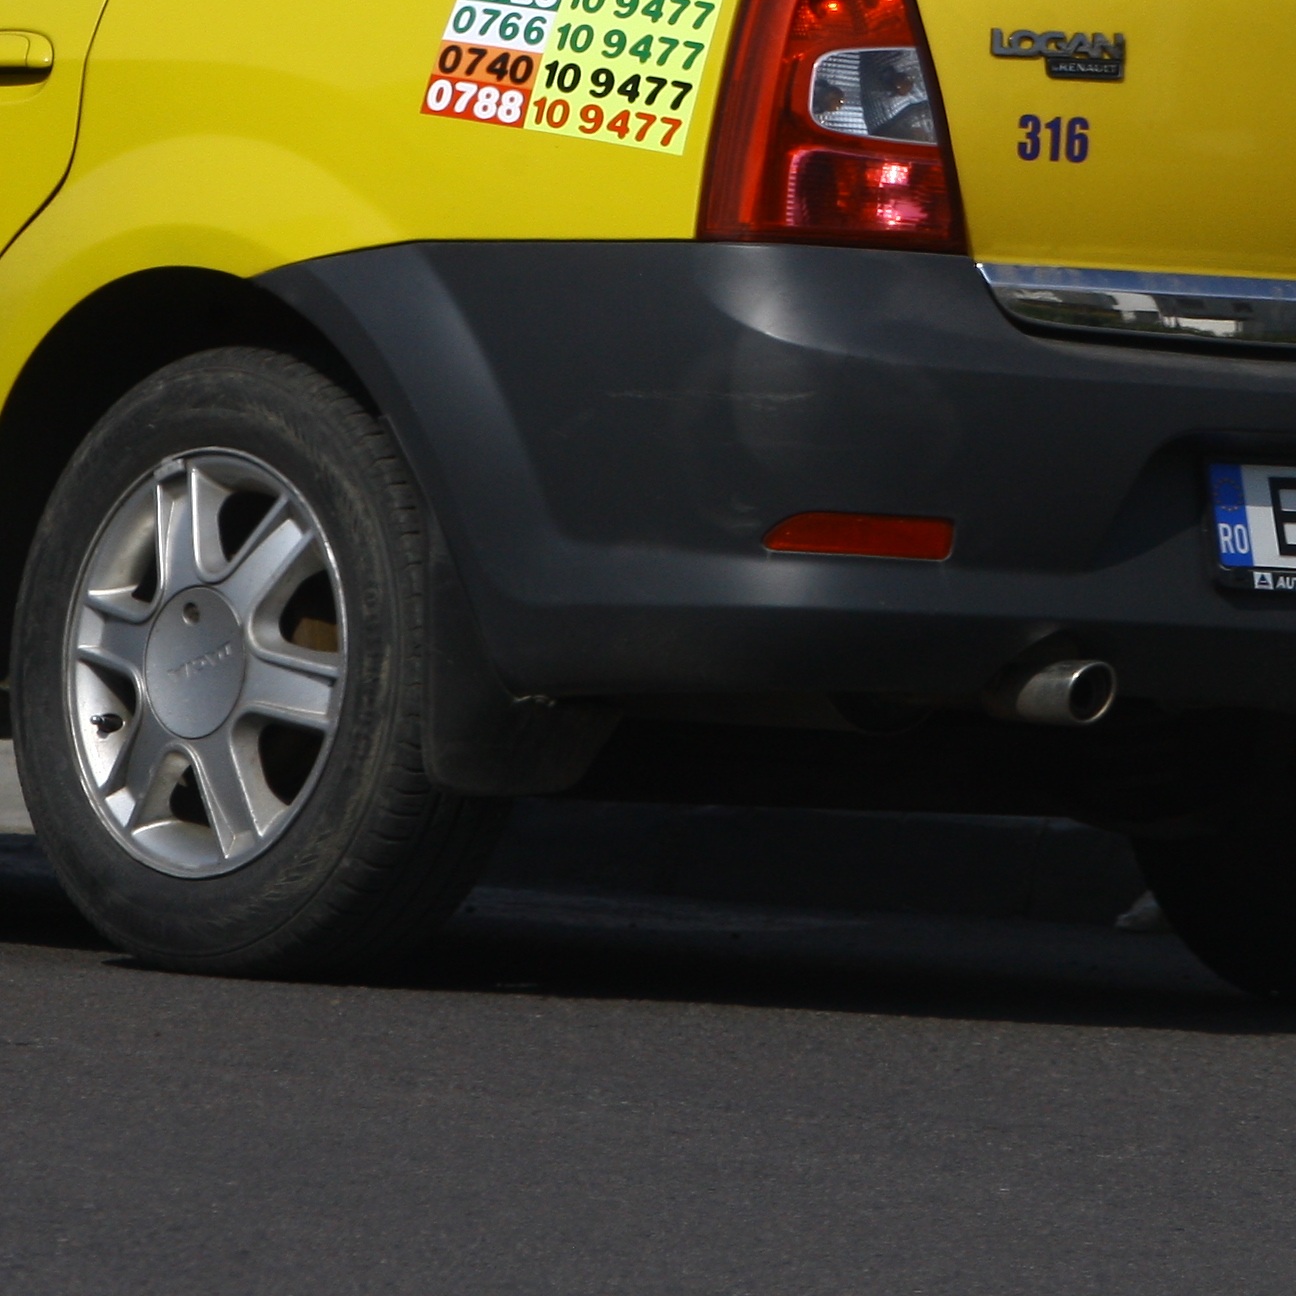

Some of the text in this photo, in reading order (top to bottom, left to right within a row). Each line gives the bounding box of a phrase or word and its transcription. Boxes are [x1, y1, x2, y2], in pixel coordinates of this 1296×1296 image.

[452, 5, 705, 71] 0766 10 9477
[991, 28, 1126, 59] LOGAN
[438, 44, 693, 111] 0740 10 9477
[426, 78, 682, 147] 0788 10 9477
[1017, 114, 1090, 164] 316
[1218, 523, 1250, 554] RO
